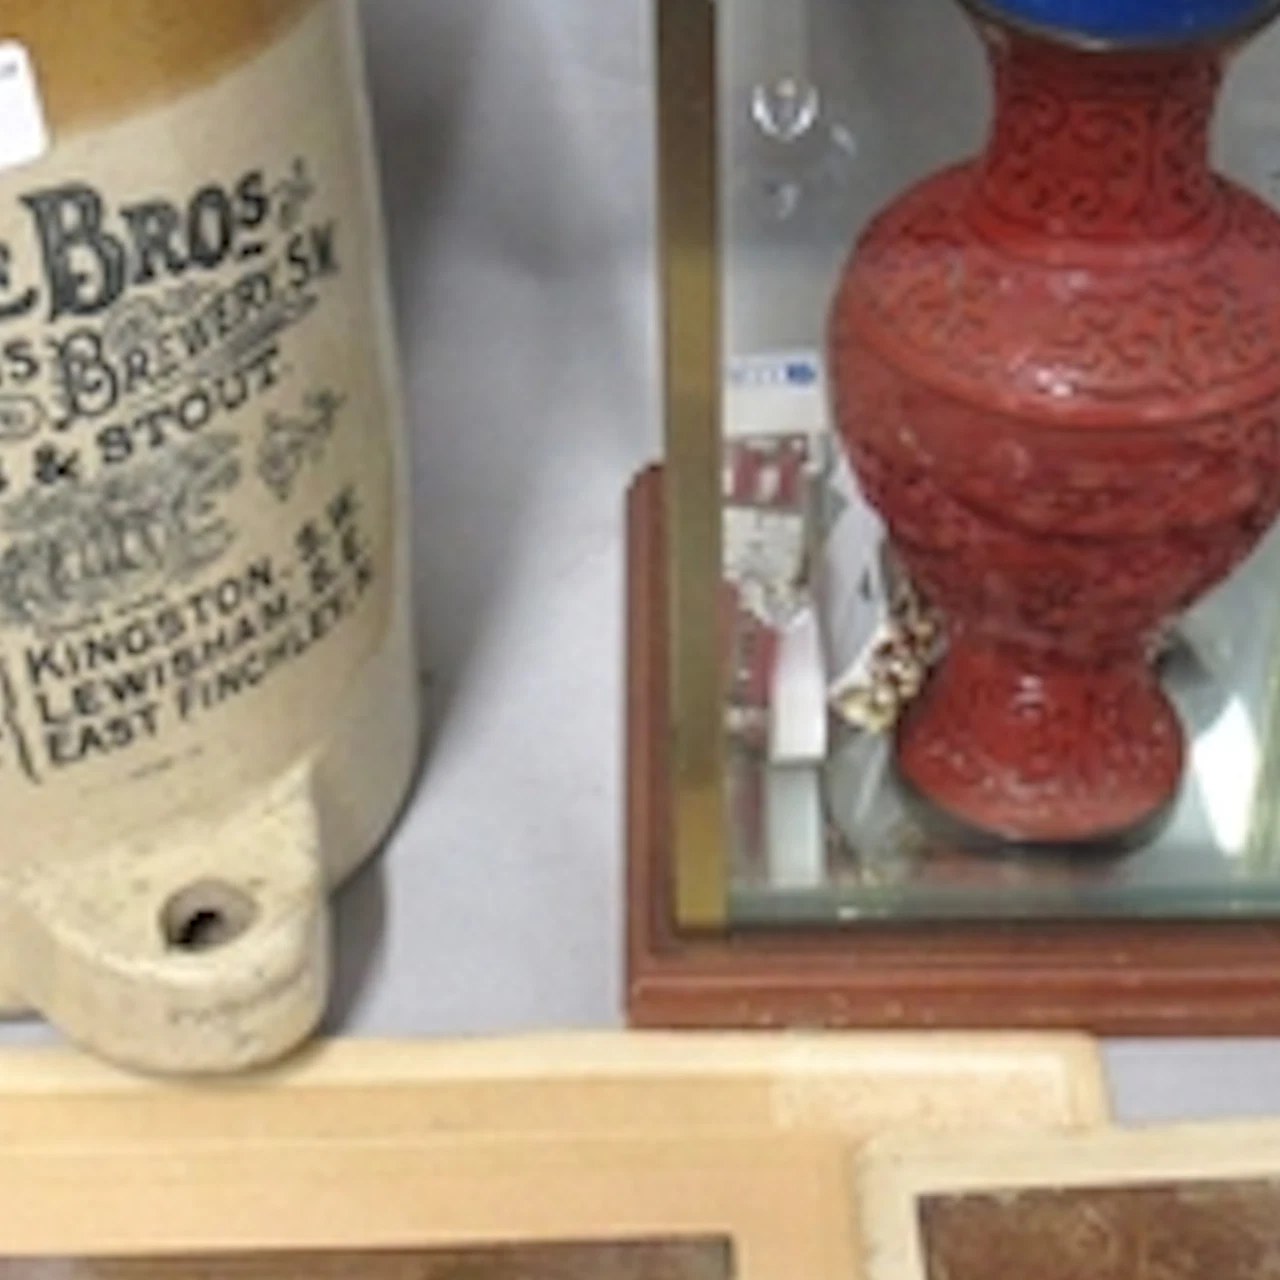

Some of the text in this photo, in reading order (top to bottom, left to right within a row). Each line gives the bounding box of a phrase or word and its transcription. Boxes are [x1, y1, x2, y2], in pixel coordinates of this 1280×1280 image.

[34, 442, 79, 485] &
[96, 345, 280, 464] STOUT
[48, 703, 159, 767] EAST
